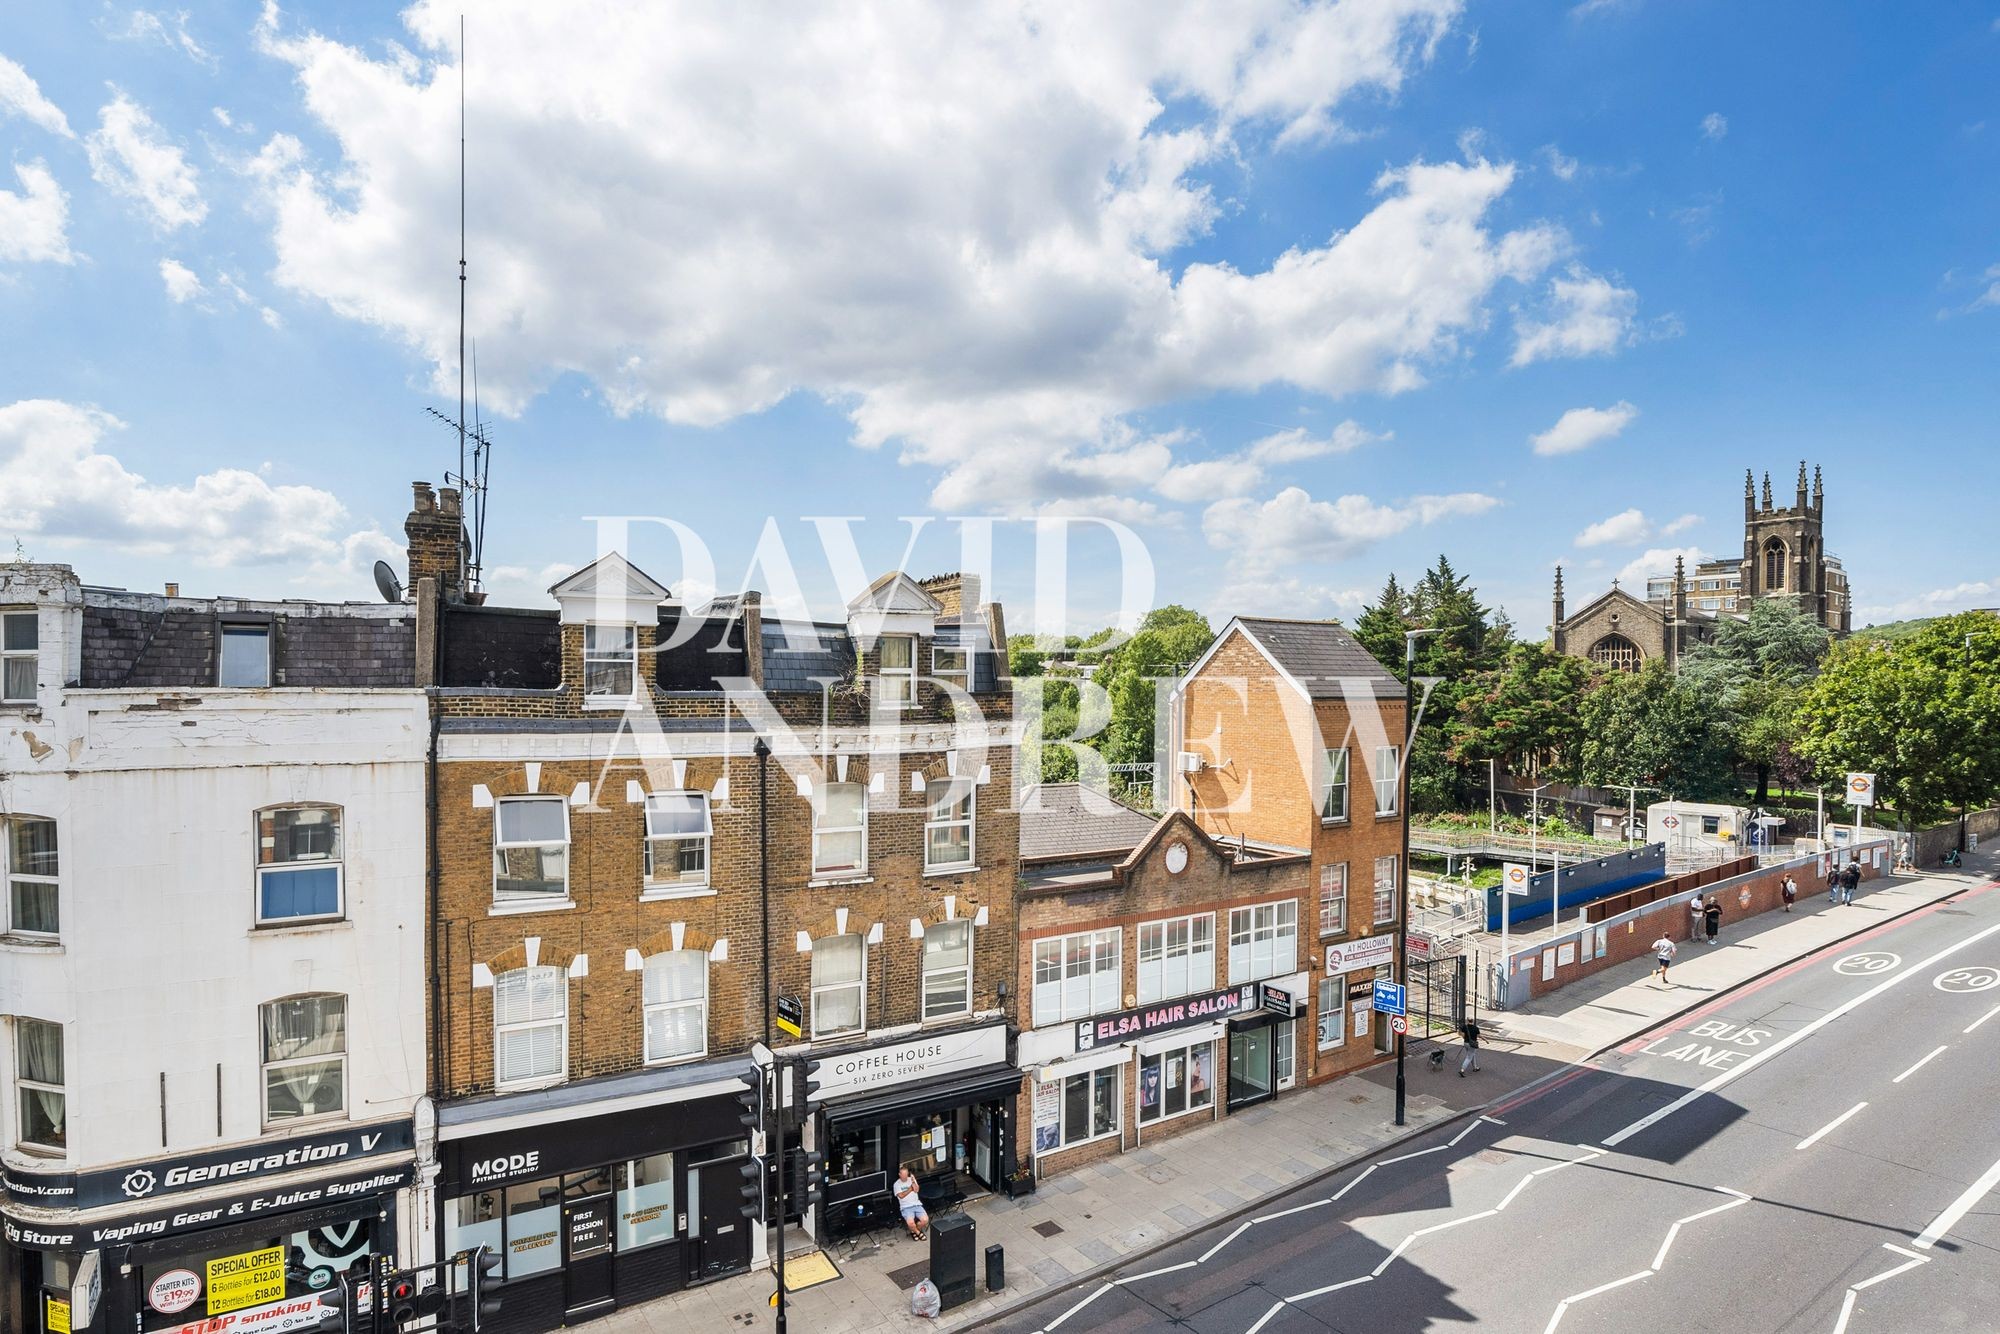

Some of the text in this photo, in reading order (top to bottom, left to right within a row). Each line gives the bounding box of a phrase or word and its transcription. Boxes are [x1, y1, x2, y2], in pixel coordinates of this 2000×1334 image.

[1357, 936, 1390, 951] HOLLOWAY
[1843, 956, 1889, 970] 20
[1943, 972, 1994, 987] 20
[1098, 1016, 1142, 1040] ELSA
[1145, 1005, 1184, 1028] HAIR
[1188, 992, 1238, 1018] SALON
[1394, 1020, 1405, 1030] 20
[1688, 1020, 1772, 1046] BUS
[836, 1045, 942, 1075] COFFEE HOUSE
[1640, 1037, 1752, 1070] LANE
[853, 1064, 925, 1084] SIX ZERO SEVEN
[164, 1132, 382, 1187] Generation V
[472, 1150, 539, 1178] MODE
[93, 1220, 167, 1242] Vaping
[172, 1208, 223, 1226] Gear
[228, 1202, 244, 1215] &
[250, 1189, 322, 1212] E-Juice
[326, 1173, 404, 1197] Supplier
[574, 1211, 593, 1221] FIRST
[573, 1219, 603, 1232] SESSION
[23, 1230, 73, 1245] Store
[574, 1232, 596, 1243] FREE.
[211, 1251, 281, 1276] SPECIAL OFFER
[156, 1277, 195, 1293] STARTER KITS
[212, 1269, 281, 1293] 6 Bottles for £12.00
[164, 1289, 194, 1302] £19.99
[211, 1286, 281, 1310] 12 Bottles for £18.00
[181, 1301, 312, 1334] STOP smoking
